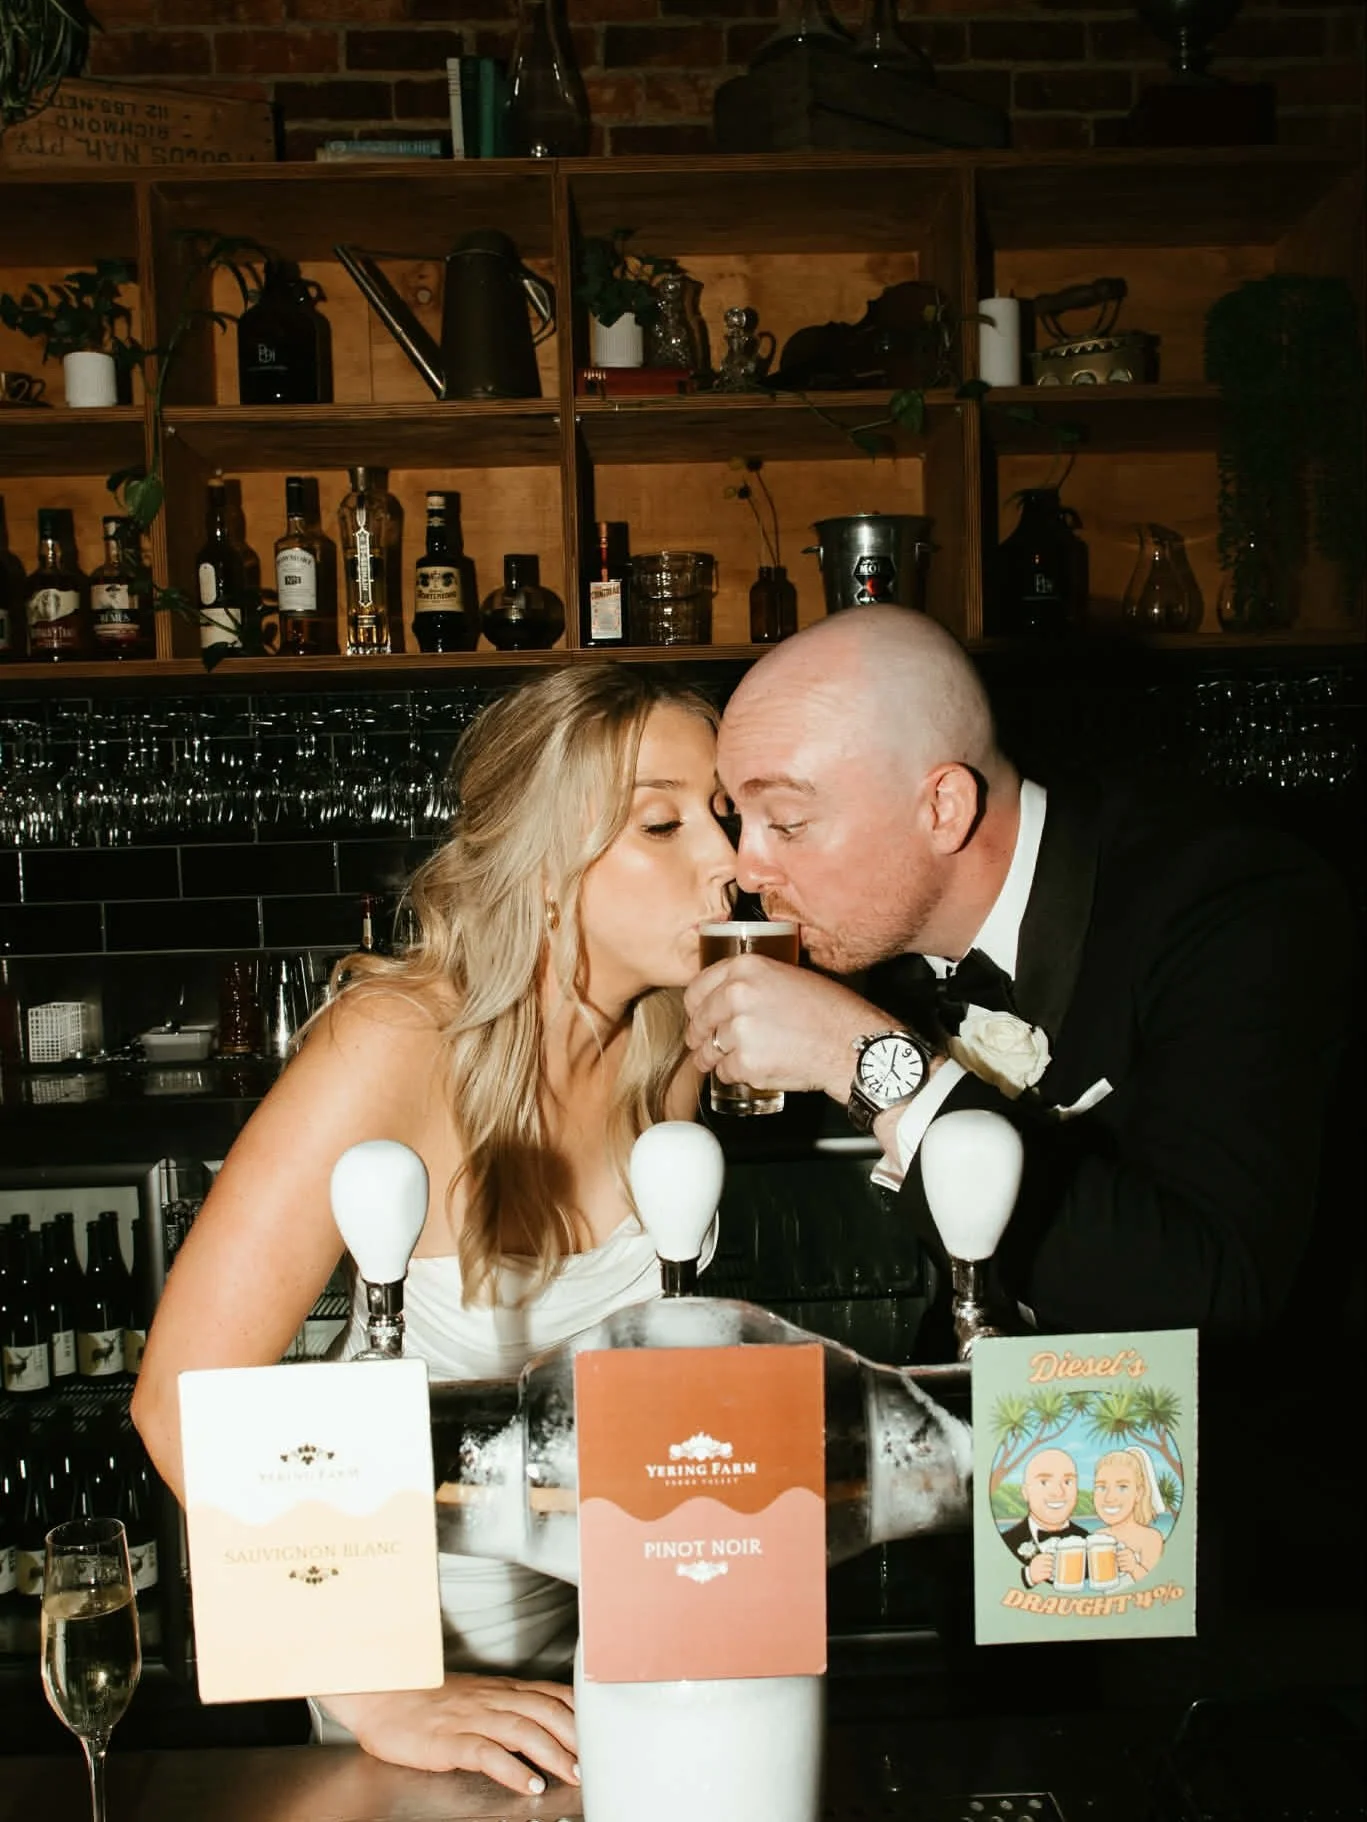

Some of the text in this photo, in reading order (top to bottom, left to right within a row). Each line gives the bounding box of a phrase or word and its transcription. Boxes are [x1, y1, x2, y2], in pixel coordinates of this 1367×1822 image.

[56, 115, 170, 139] RICHMOND
[1028, 1348, 1148, 1384] Diesel's
[645, 1461, 757, 1478] YERING FARM
[224, 1539, 402, 1565] SAUVIGNON BLANC
[644, 1538, 763, 1559] PINOT NOIR
[1001, 1581, 1186, 1617] DRAUGHT 4%
